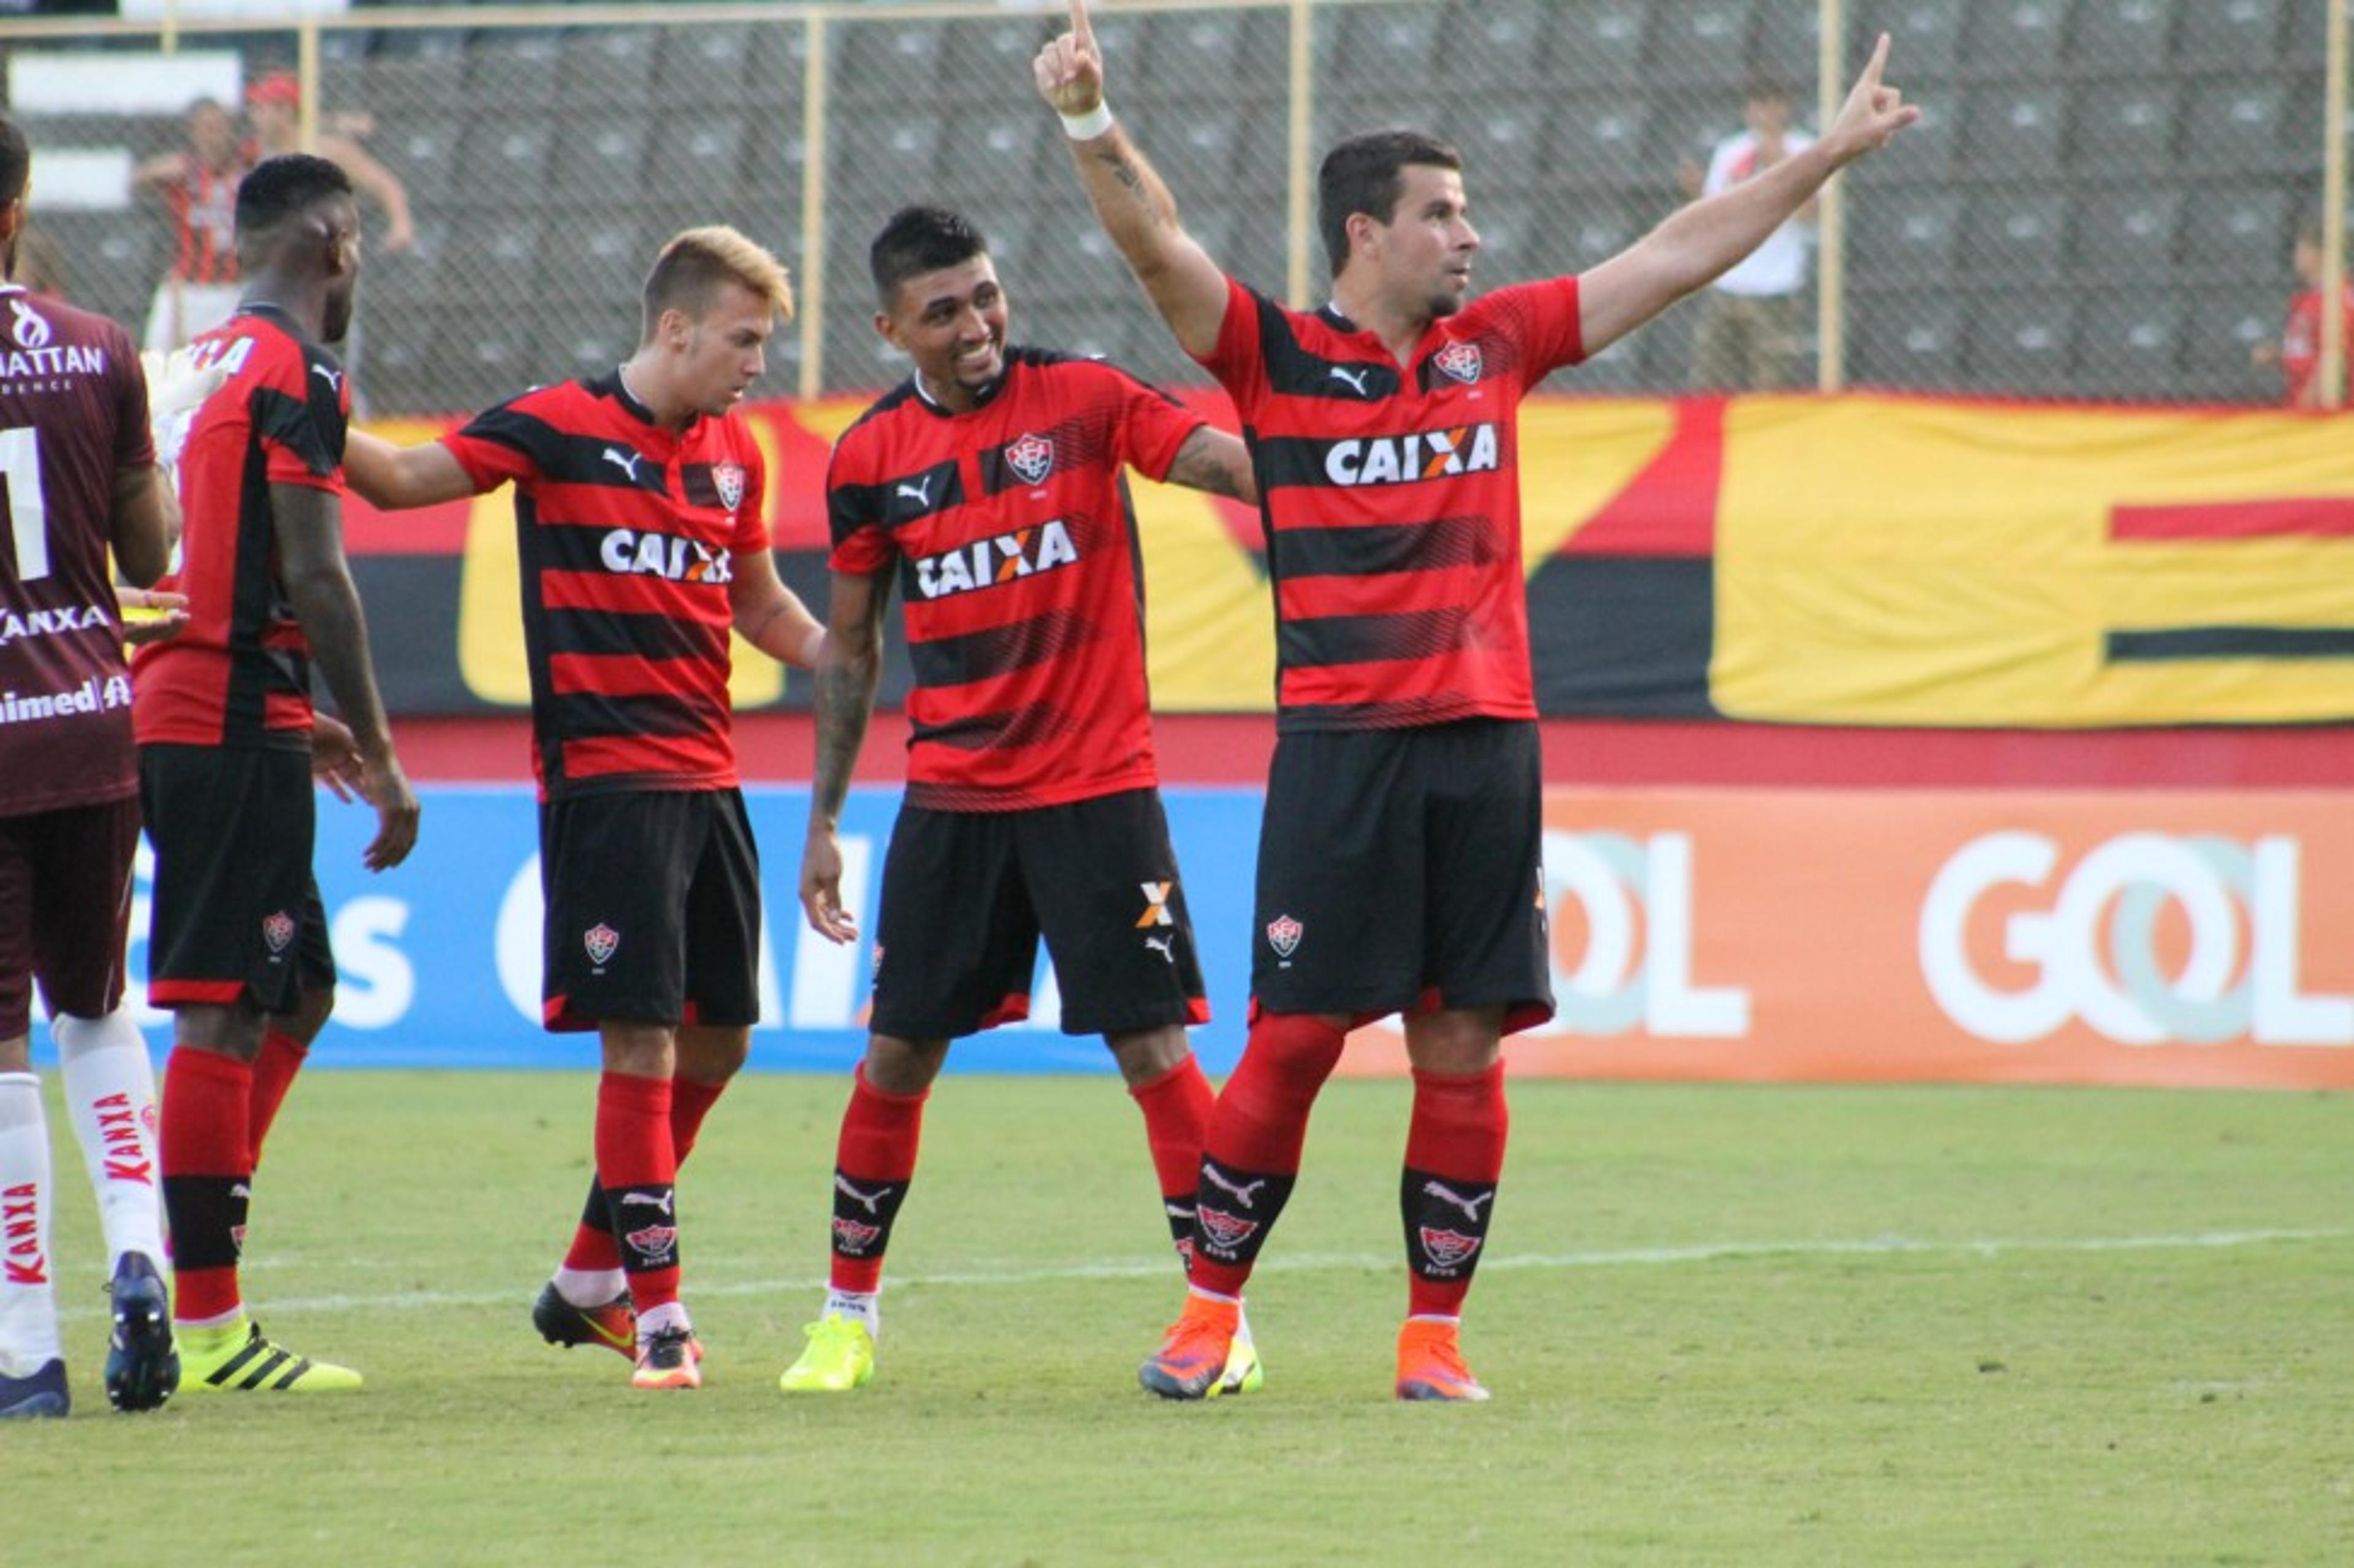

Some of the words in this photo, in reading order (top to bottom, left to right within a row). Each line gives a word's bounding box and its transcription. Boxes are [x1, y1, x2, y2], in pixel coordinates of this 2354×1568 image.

[1325, 424, 1496, 486] CAIXA
[916, 520, 1078, 598] CAIXA
[1919, 829, 2354, 1044] GOL
[93, 1092, 153, 1186] KANXA
[2, 1182, 48, 1284] KANXA
